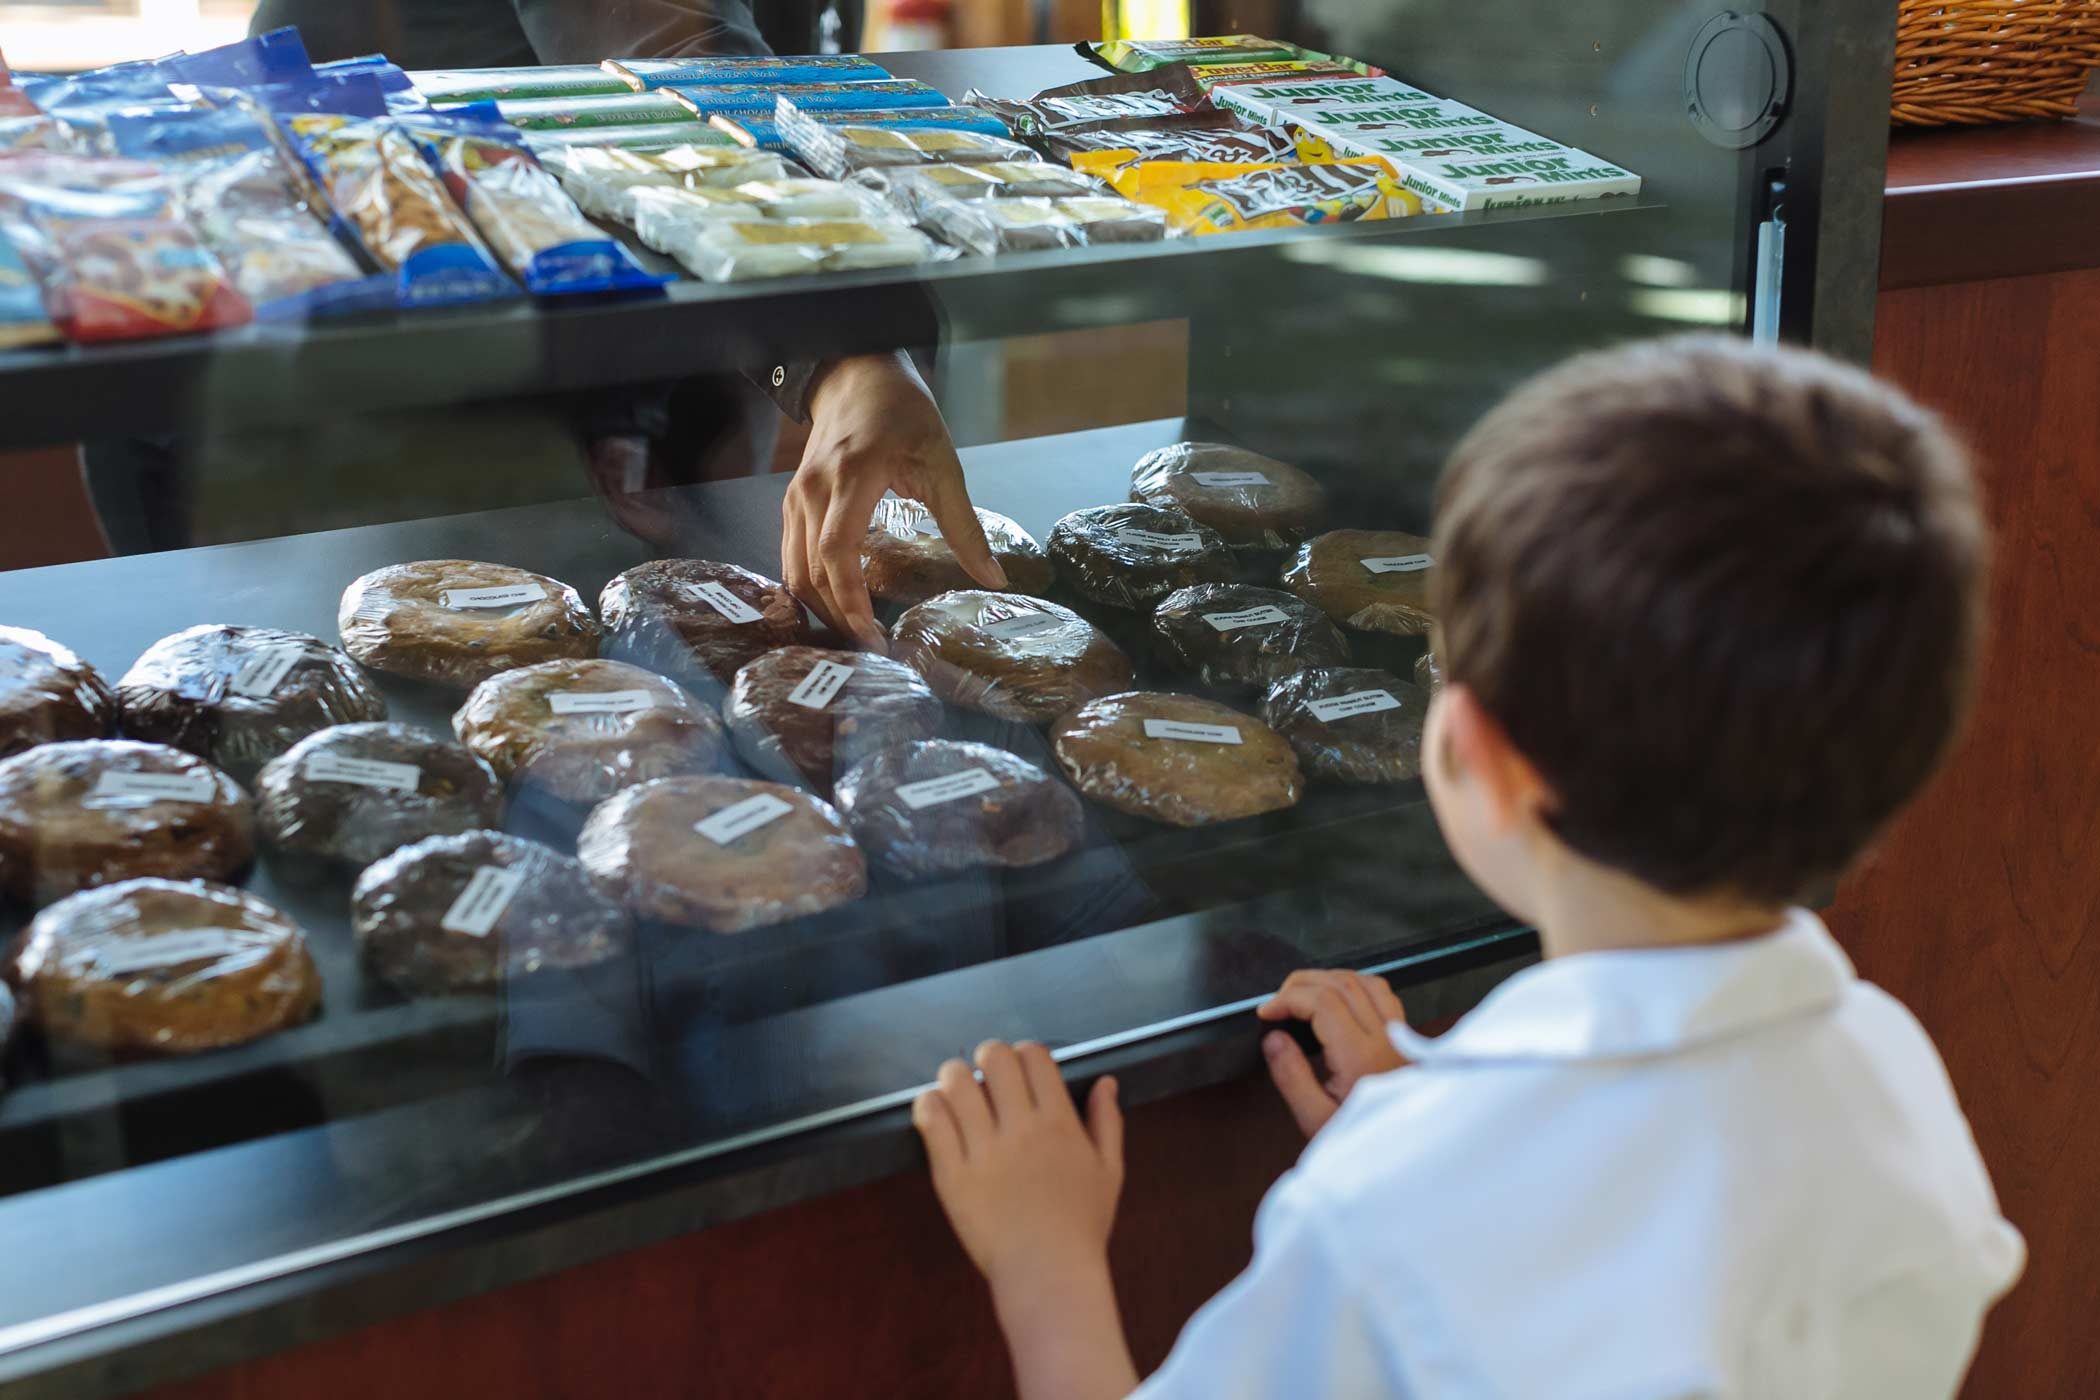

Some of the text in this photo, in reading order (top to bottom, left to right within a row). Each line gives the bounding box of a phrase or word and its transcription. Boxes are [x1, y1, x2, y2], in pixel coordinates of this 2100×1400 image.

[1191, 62, 1294, 79] PowerBar
[1199, 70, 1248, 84] HARVEST
[1252, 82, 1378, 98] Junior
[1341, 91, 1430, 103] Mints
[1215, 96, 1268, 126] Junior Mints
[1316, 107, 1443, 124] Junior
[1405, 115, 1496, 129] Mints
[1378, 132, 1508, 152] Junior
[1470, 141, 1561, 155] Mints
[1441, 155, 1572, 178] Junior
[1534, 166, 1626, 183] Mints
[1402, 174, 1462, 209] Junior Mints
[469, 593, 509, 601] CHOCOLATE
